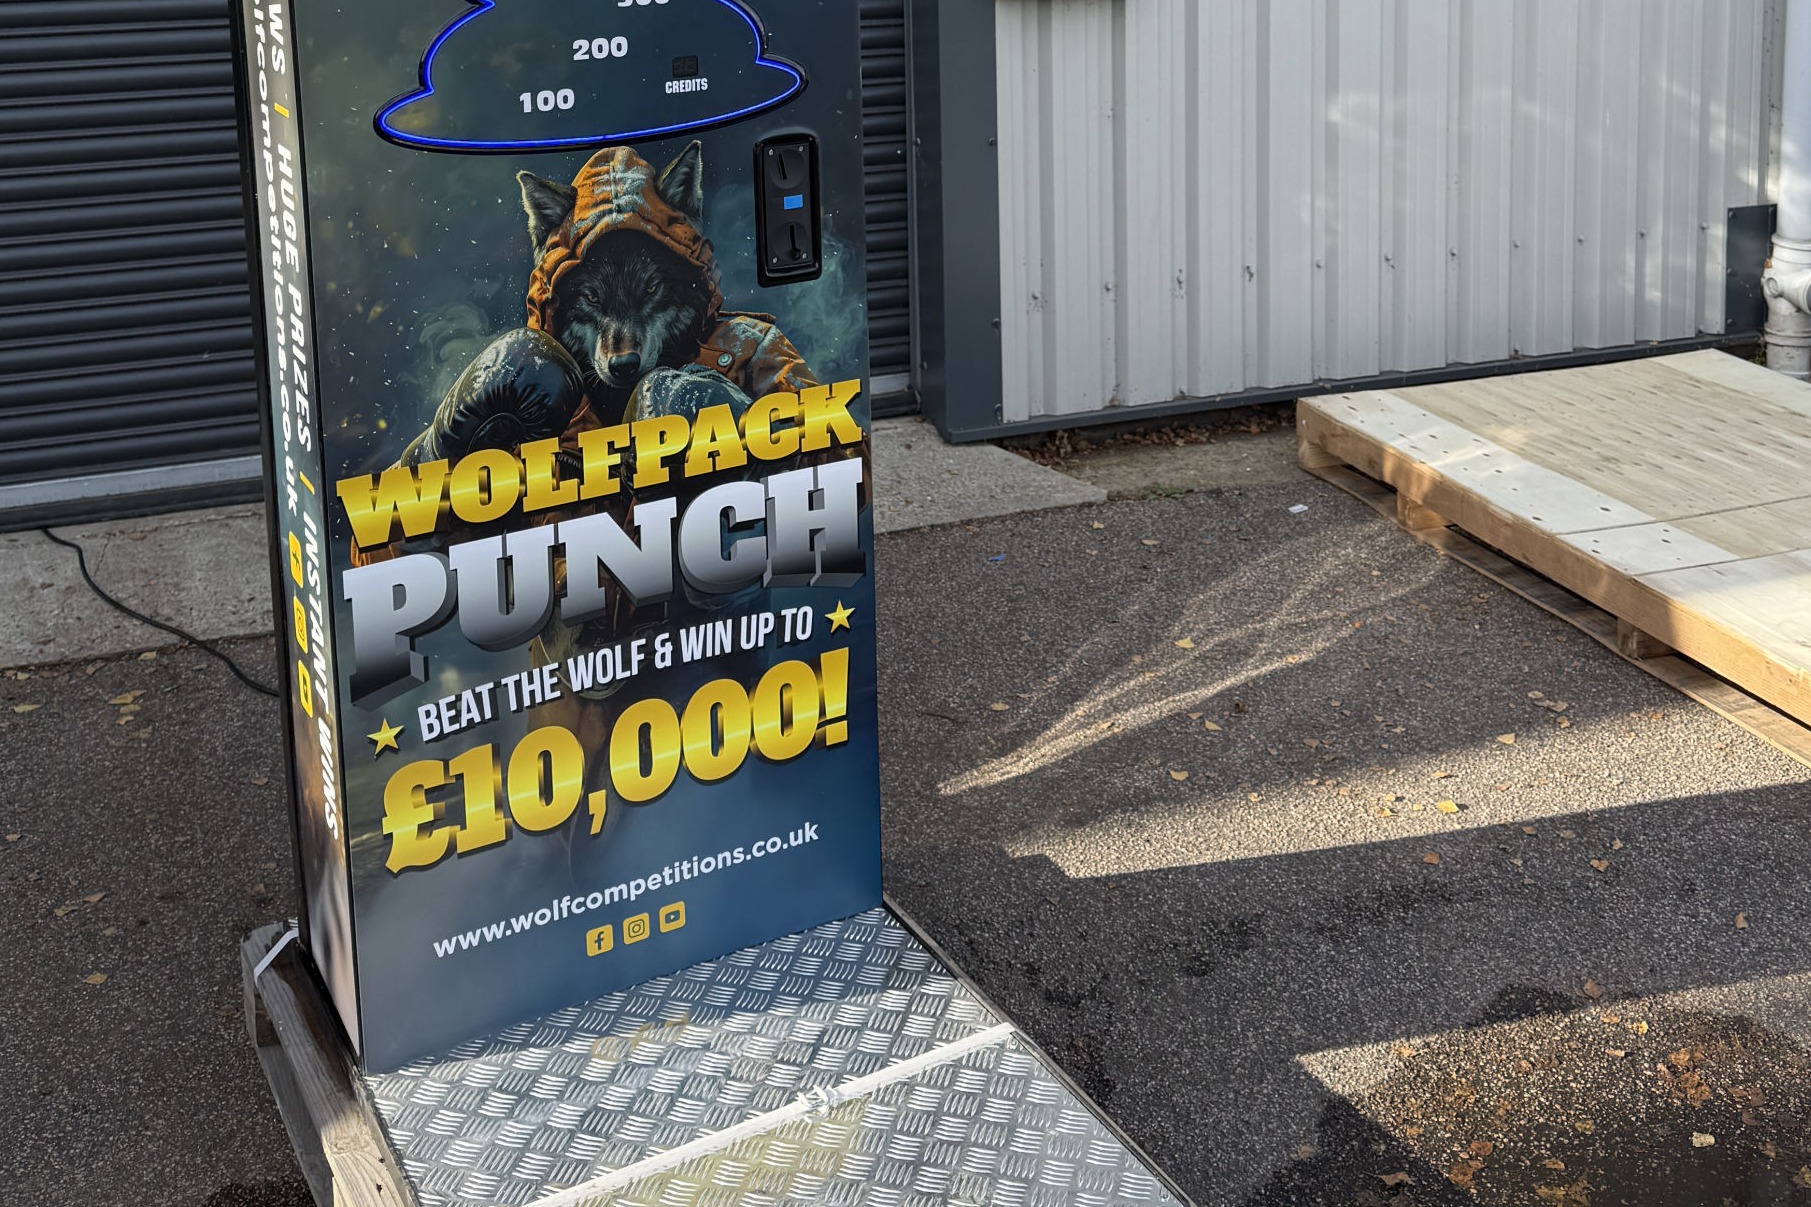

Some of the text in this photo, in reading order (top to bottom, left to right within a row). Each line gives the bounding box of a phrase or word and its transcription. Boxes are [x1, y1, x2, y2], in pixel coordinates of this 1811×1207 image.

[519, 89, 575, 112] 100
[572, 37, 628, 61] 200
[665, 78, 708, 94] CREDITS
[277, 143, 299, 276] HUGE
[287, 281, 312, 453] PRIZES
[336, 379, 864, 547] WOLFPACK
[303, 512, 329, 715] INSTANT
[342, 458, 867, 706] PUNCH
[418, 605, 814, 742] BEAT THE WOLF & WIN UP TO
[317, 717, 339, 841] WINS
[382, 647, 851, 875] £10,000!
[433, 822, 820, 958] www.wolfcompetitions.co.uk
